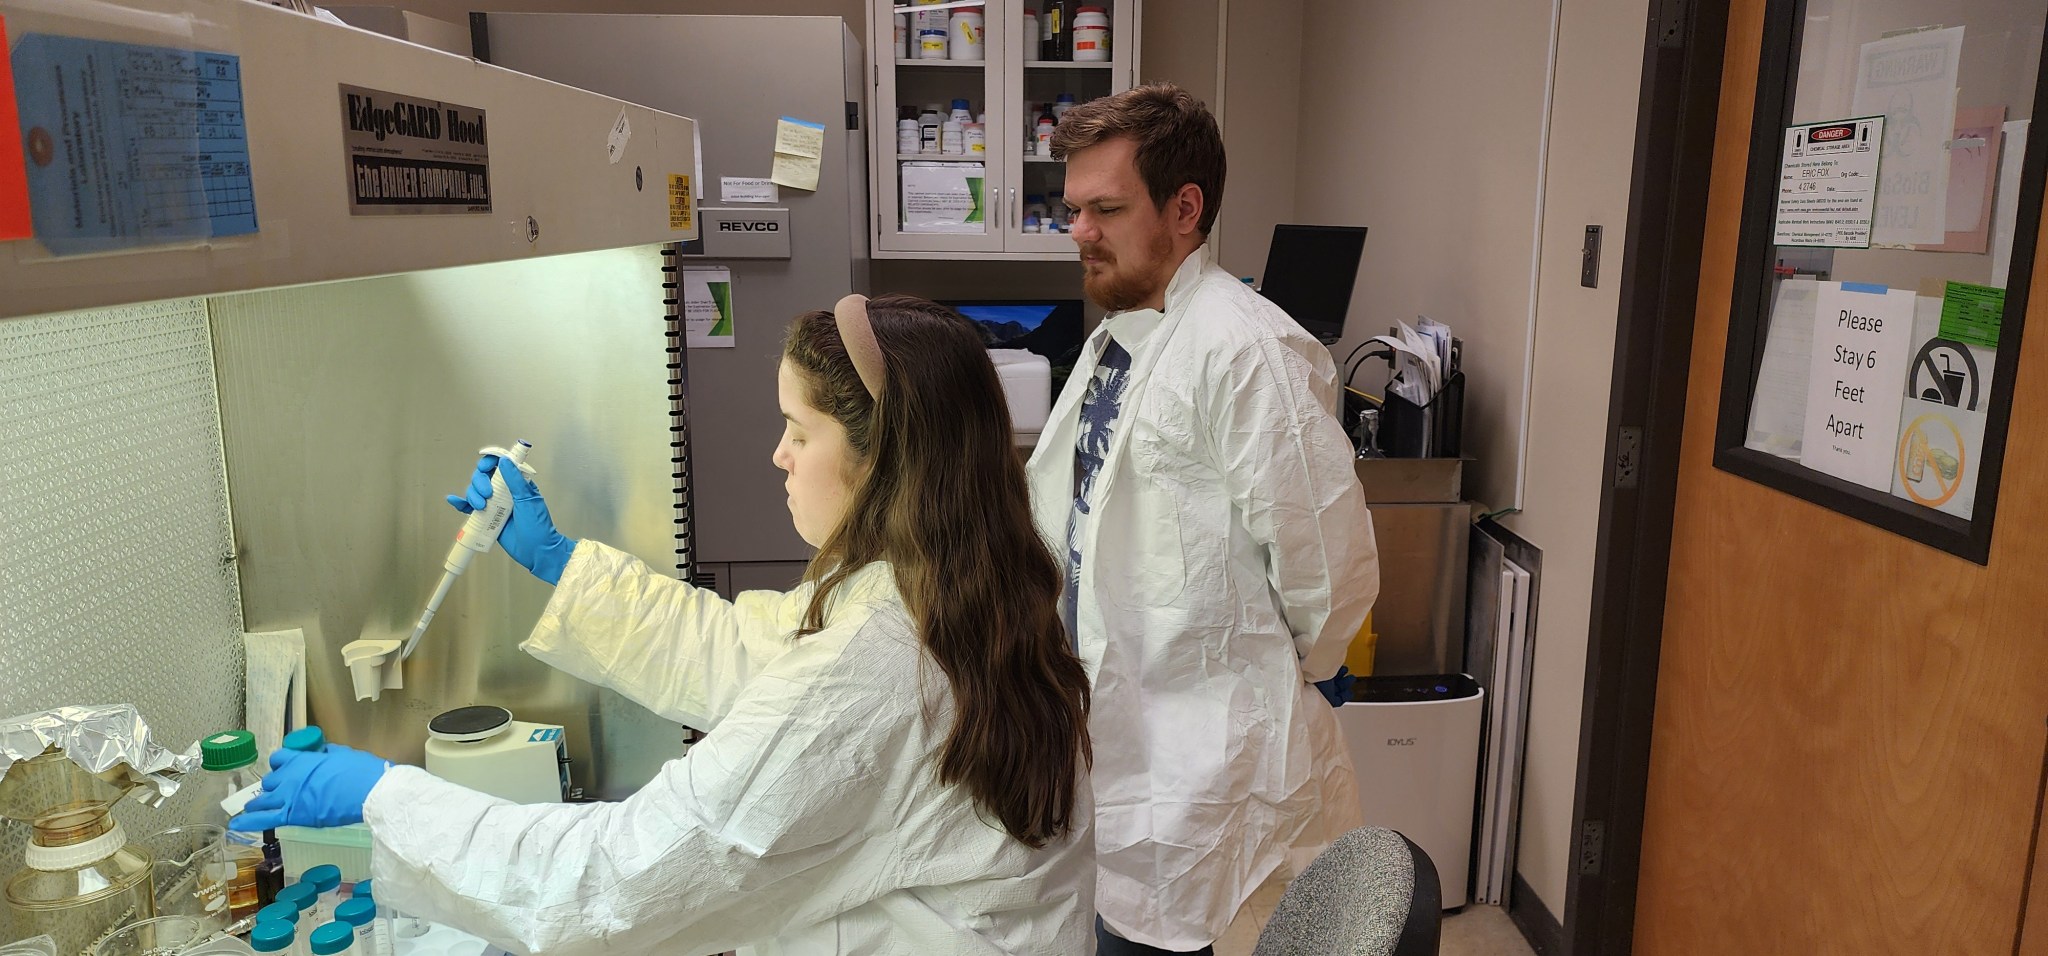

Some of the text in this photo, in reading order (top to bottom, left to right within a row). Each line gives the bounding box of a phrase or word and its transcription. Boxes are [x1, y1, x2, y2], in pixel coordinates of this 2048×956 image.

[446, 109, 485, 145] Hood
[1818, 129, 1844, 139] DANGER
[356, 164, 380, 198] the
[380, 165, 419, 198] BAKER
[1802, 168, 1830, 177] ERIC FOX
[720, 222, 778, 231] REVCO
[1838, 309, 1883, 333] Please
[1834, 345, 1876, 371] Stay 6
[1834, 380, 1865, 403] Feet
[1825, 414, 1864, 440] Apart
[1832, 445, 1842, 453] Thank
[192, 884, 217, 898] VWR
